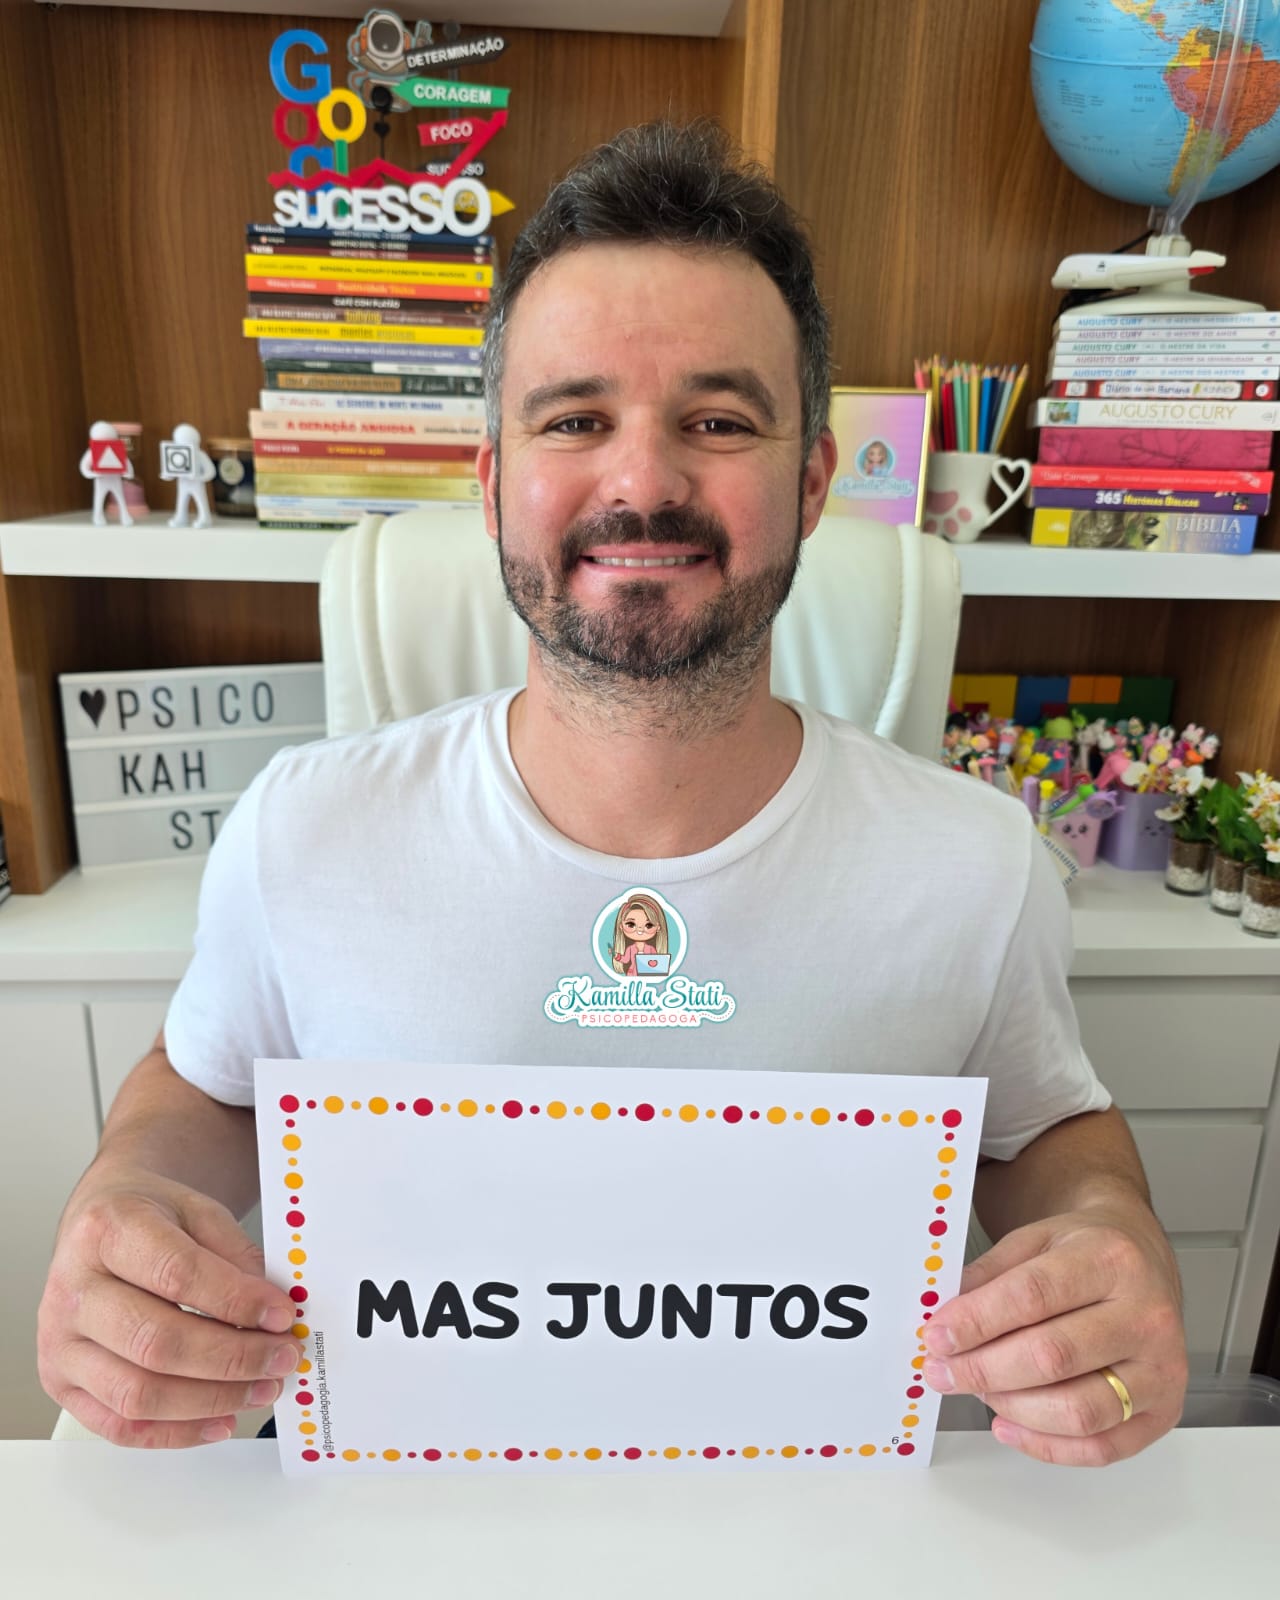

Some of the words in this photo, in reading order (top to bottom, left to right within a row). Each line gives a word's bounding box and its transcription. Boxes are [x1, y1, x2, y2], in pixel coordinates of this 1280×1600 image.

[406, 37, 504, 68] DETERMINAÇÃO
[413, 84, 492, 104] CORAGEM
[430, 121, 474, 142] FOCO
[273, 177, 491, 237] SUCESSO
[1077, 318, 1117, 327] AUGUSTO
[1119, 318, 1144, 326] CURY
[1077, 330, 1117, 339] AUGUSTO
[1119, 330, 1143, 338] CURY
[1072, 343, 1113, 352] AUGUSTO
[1115, 342, 1137, 351] CURY
[1075, 355, 1116, 364] AUGUSTO
[1117, 355, 1141, 363] CURY
[1072, 369, 1113, 378] AUGUSTO
[1115, 368, 1137, 377] CURY
[1105, 383, 1131, 393] Diário
[1099, 403, 1186, 420] AUGUSTO
[1188, 404, 1238, 421] CURY
[298, 419, 357, 435] GERAÇÃO
[1096, 491, 1122, 505] 365
[1176, 513, 1241, 534] BÍBLIA
[116, 681, 274, 731] PSICO
[120, 750, 206, 795] KAH
[356, 1279, 519, 1340] MAS
[546, 1282, 870, 1340] JUNTOS
[314, 1331, 334, 1452] @psicopedagogia.kamillastati
[891, 1436, 900, 1445] 6
